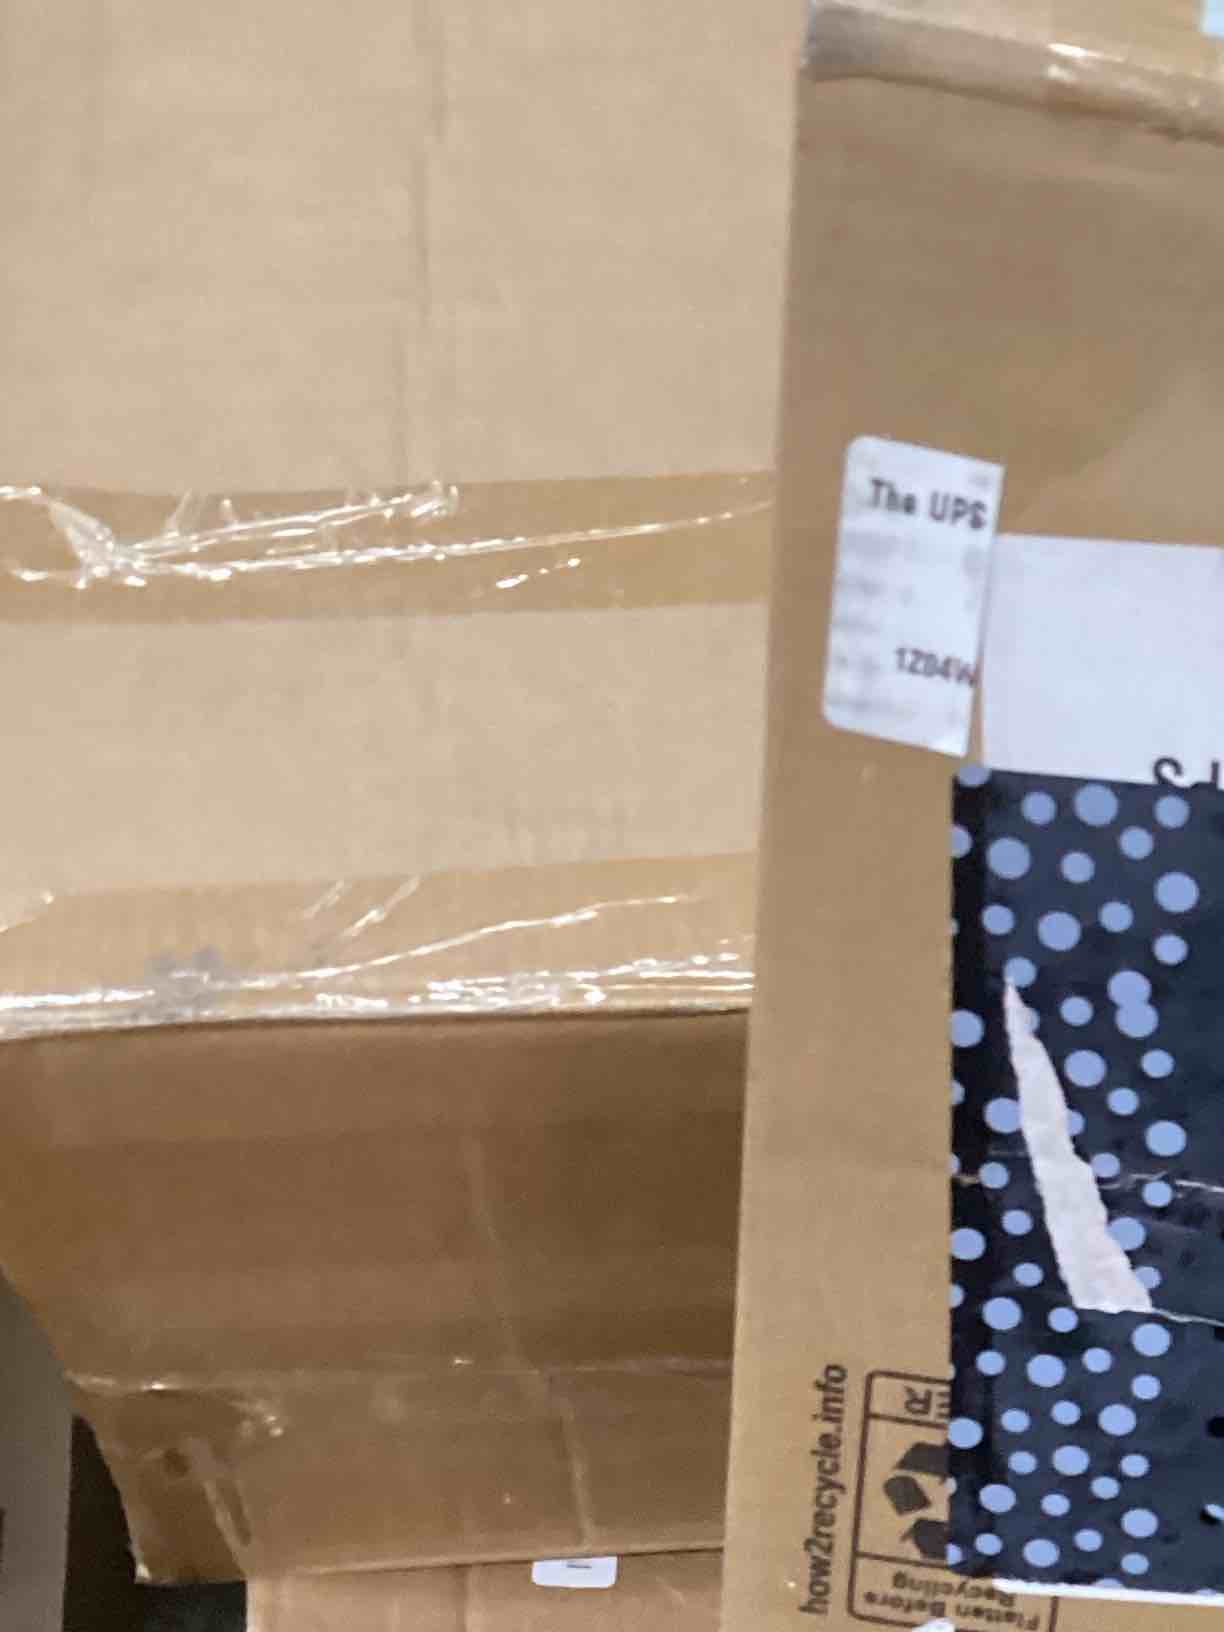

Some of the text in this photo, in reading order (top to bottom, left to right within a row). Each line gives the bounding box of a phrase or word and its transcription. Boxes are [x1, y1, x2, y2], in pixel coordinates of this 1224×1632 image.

[869, 476, 988, 531] The UPS
[798, 1363, 848, 1616] how2recycle.info
[954, 1604, 1042, 1632] Flatten
